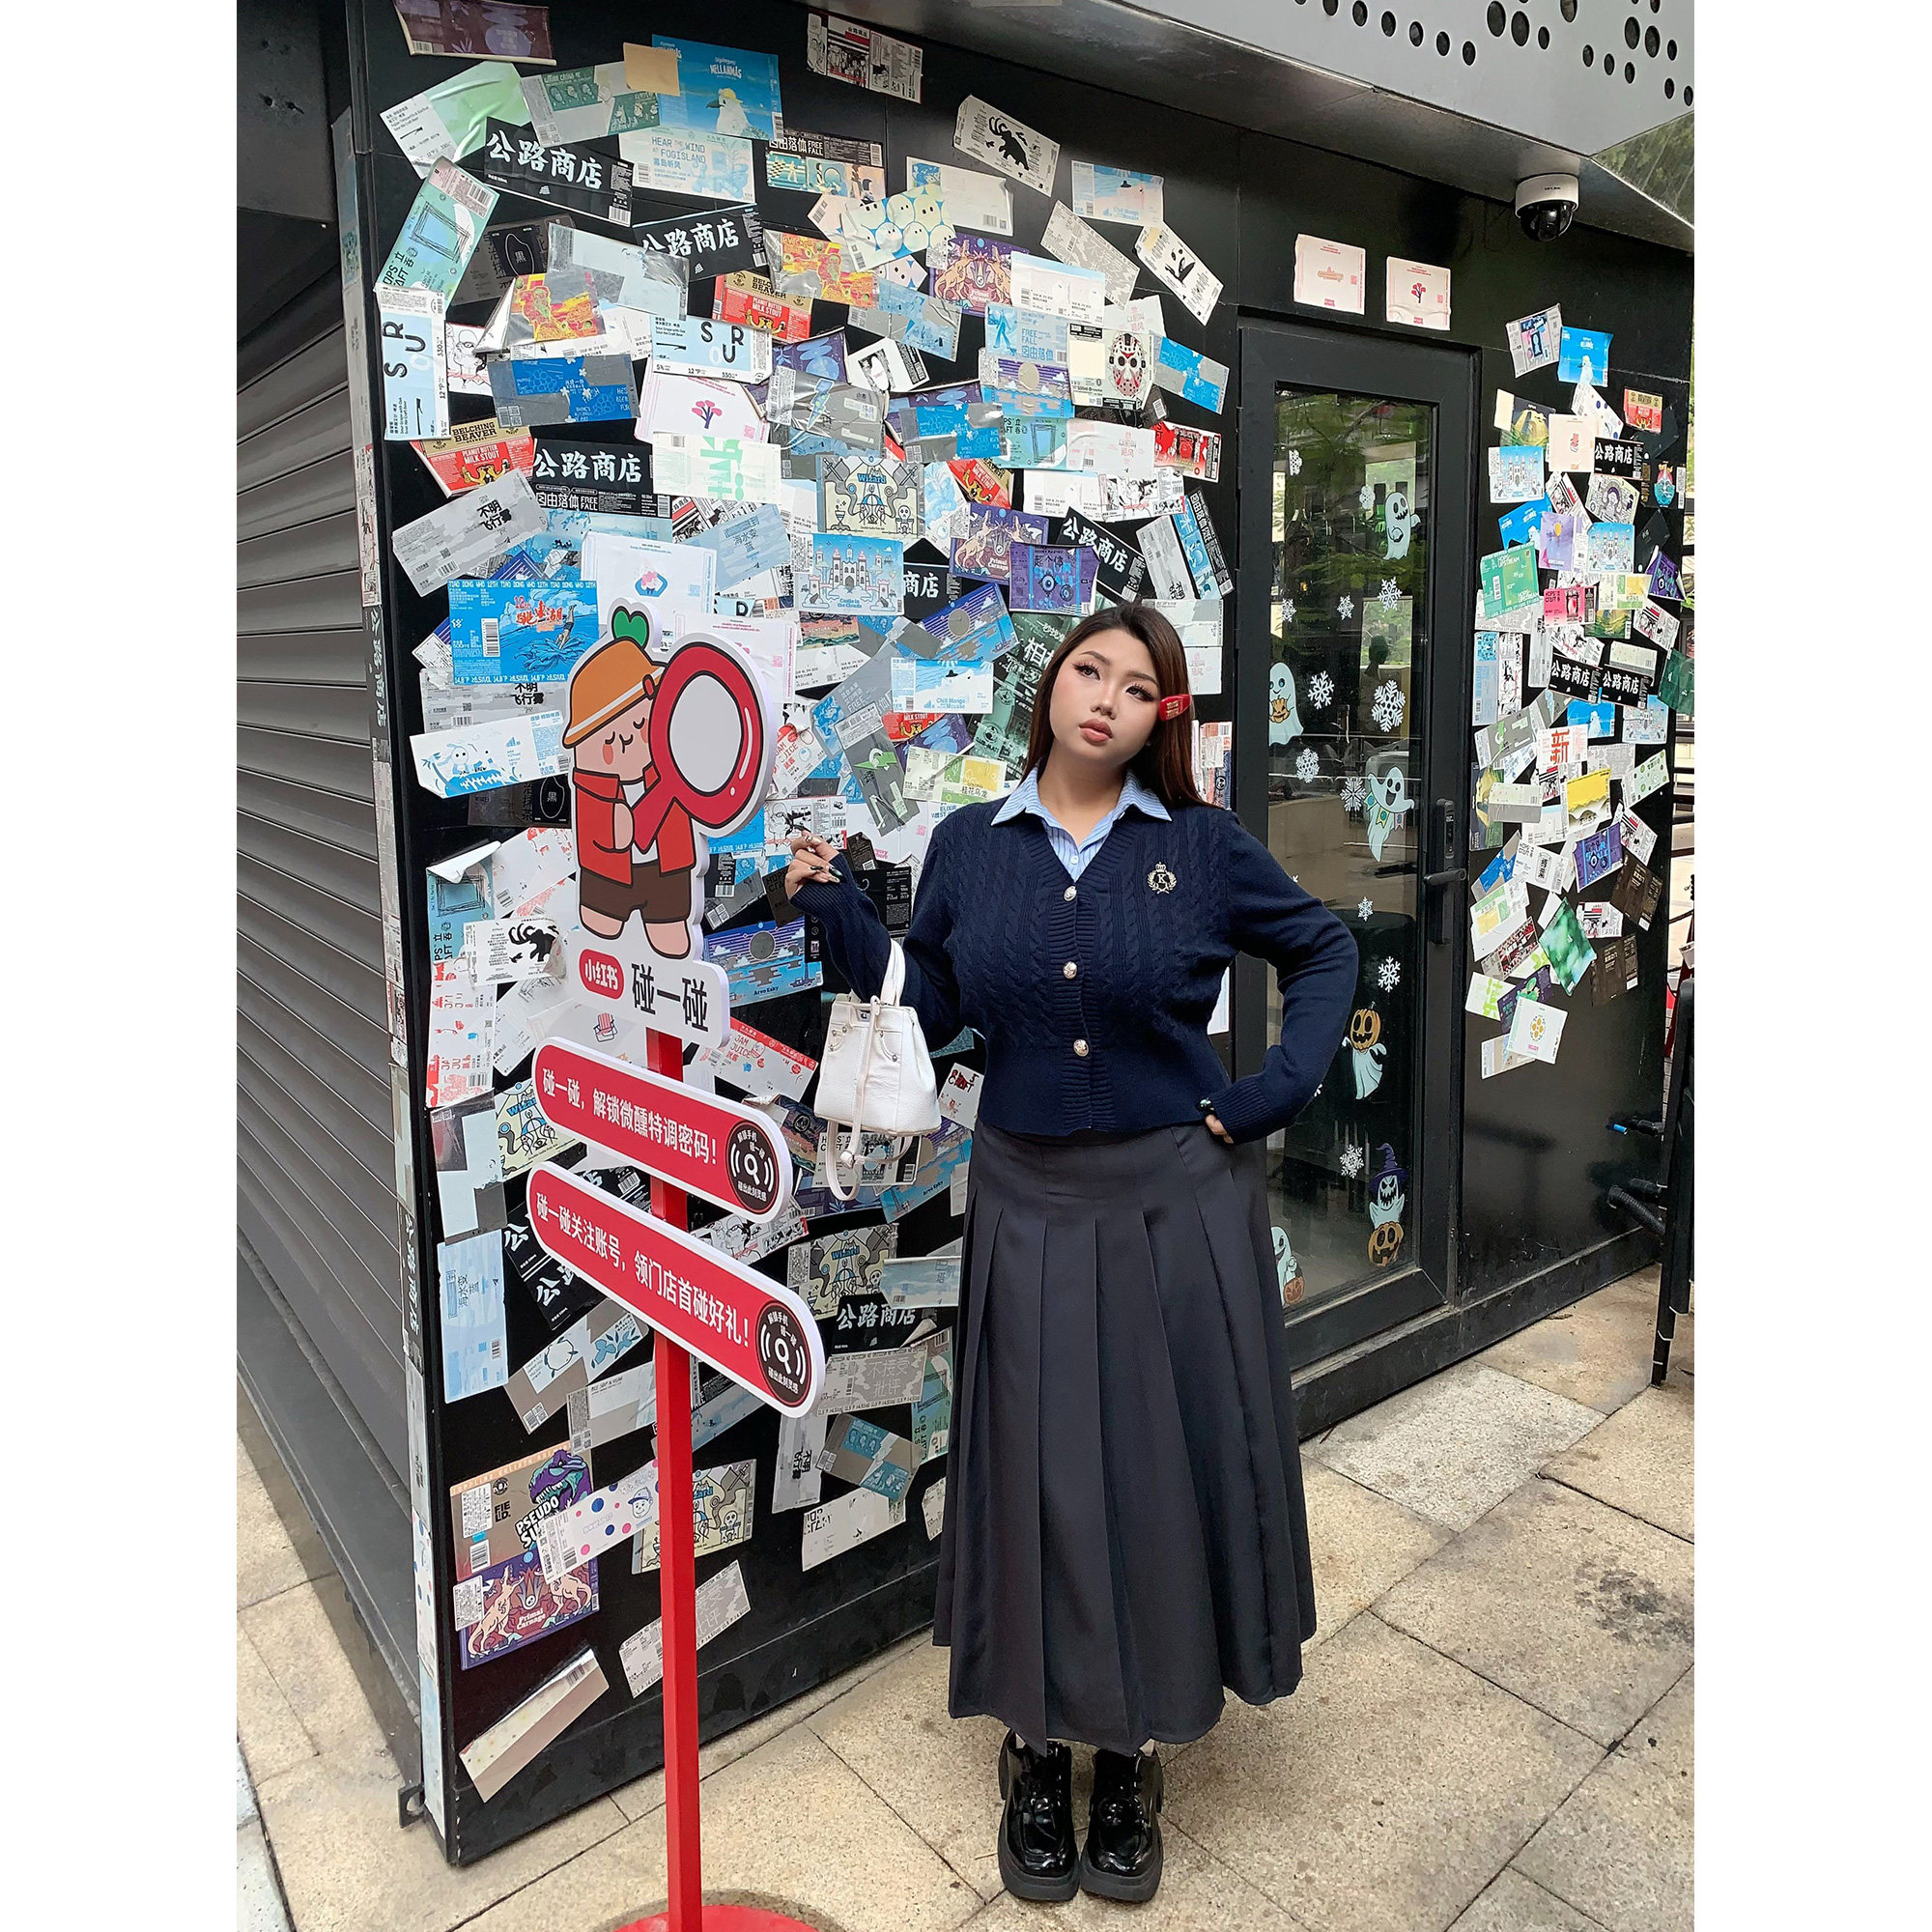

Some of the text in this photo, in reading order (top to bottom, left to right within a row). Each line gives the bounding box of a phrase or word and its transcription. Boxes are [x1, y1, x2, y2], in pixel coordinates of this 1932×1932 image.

[652, 136, 673, 147] HEAR
[685, 142, 705, 153] WIND
[808, 147, 823, 156] FALL
[486, 129, 603, 190] 公路商店
[661, 149, 706, 164] FOGISLAND
[642, 219, 739, 256] 公路商店
[753, 303, 781, 317] MILK STOUT
[452, 421, 495, 436] BELCHING
[454, 428, 498, 442] BEAVER
[465, 450, 500, 464] MILK STOUT
[1595, 442, 1634, 465] 公路商店
[533, 448, 642, 483] 公路商店
[857, 473, 887, 484] Wizard
[477, 499, 503, 520] 不明
[581, 497, 598, 505] FREE
[581, 502, 598, 511] FALL
[1063, 516, 1128, 573] 公路商店
[904, 570, 939, 598] 商店
[1551, 660, 1590, 686] 公路商店
[1603, 670, 1640, 696] 公路商店
[515, 683, 538, 693] 不明
[1550, 729, 1570, 764] 新
[1156, 873, 1167, 884] K
[584, 958, 618, 990] 小红书
[632, 963, 708, 1033] 碰一碰
[729, 1043, 753, 1060] JUICE
[734, 1037, 749, 1047] JAM
[543, 1067, 717, 1165] 碰一碰，解锁微醺特调密码！
[536, 1192, 749, 1349] 碰一碰关注账号，领门店首碰好礼！
[837, 1301, 916, 1331] 公路商店
[869, 1357, 910, 1378] 不接受
[873, 1378, 901, 1397] 批评
[515, 1495, 560, 1536] PSEUDO
[517, 1613, 547, 1631] Carnage
[519, 1607, 544, 1624] Primal
